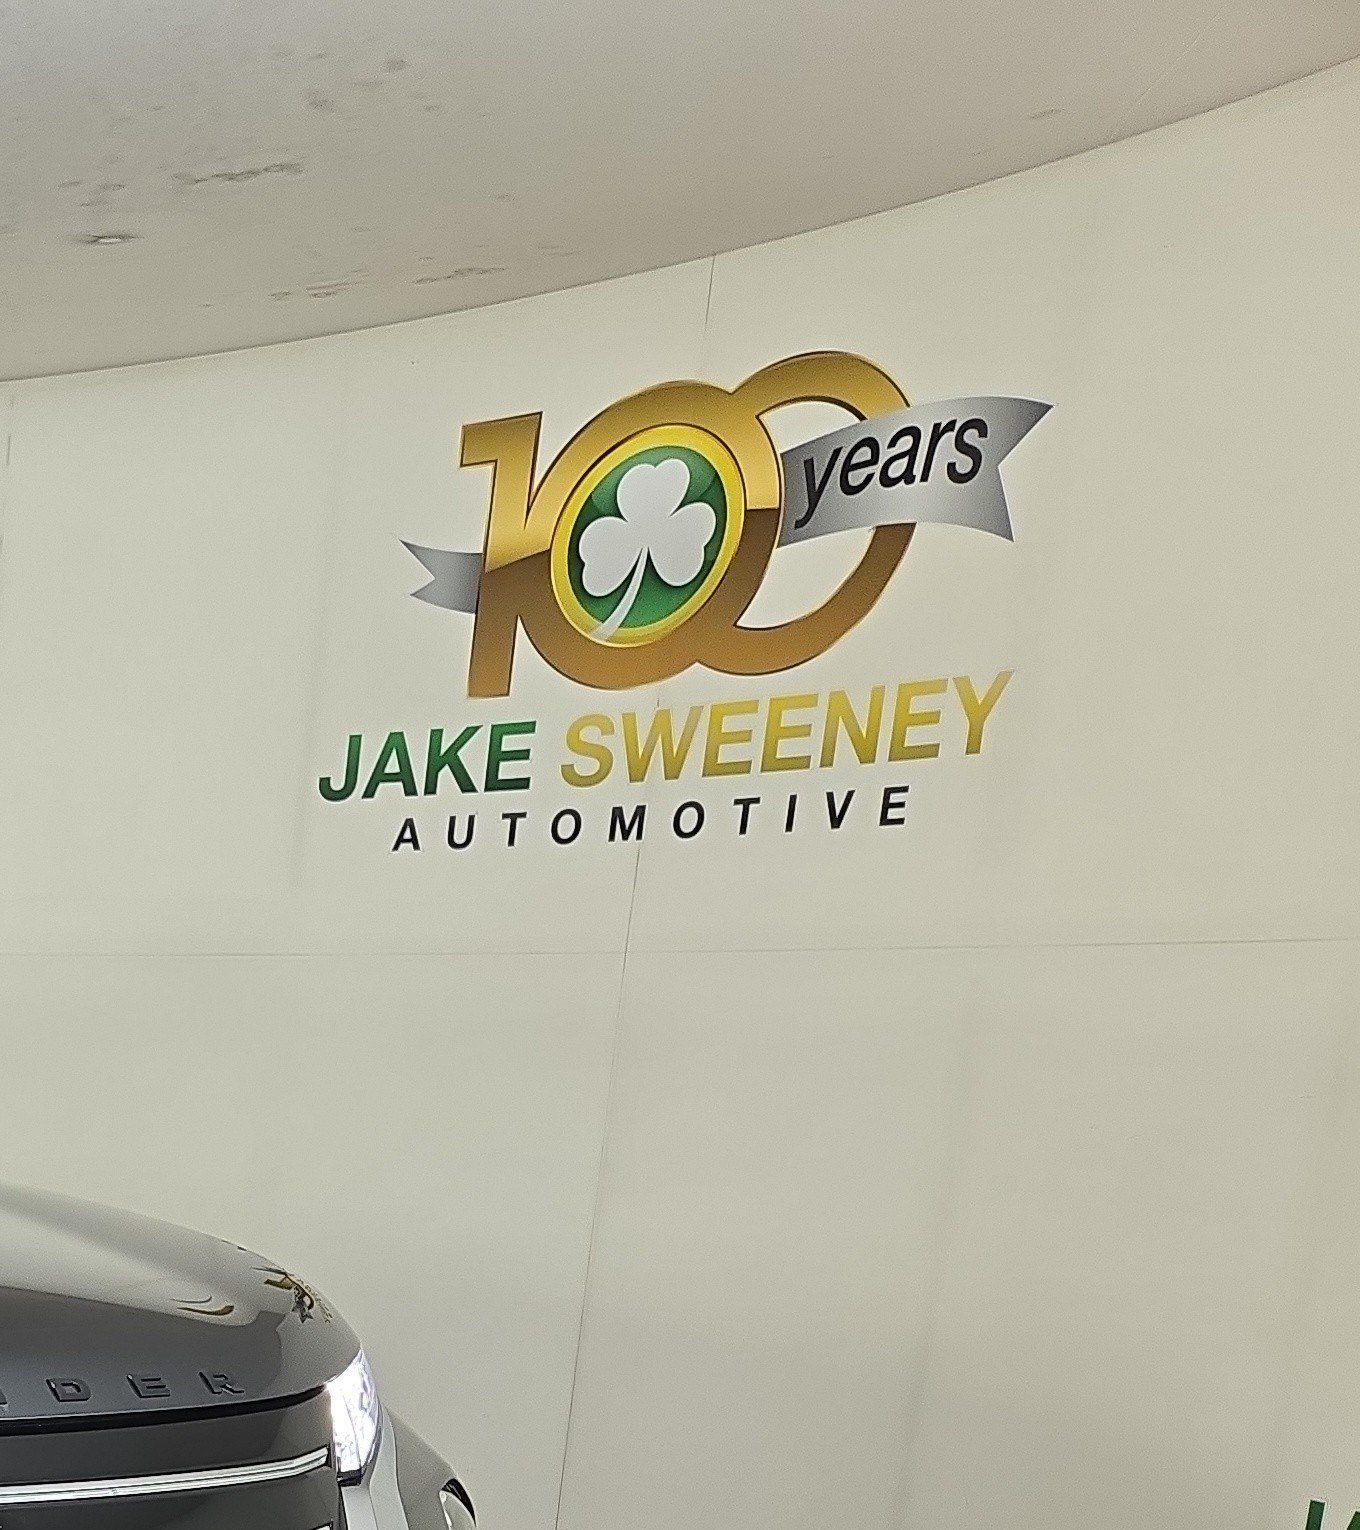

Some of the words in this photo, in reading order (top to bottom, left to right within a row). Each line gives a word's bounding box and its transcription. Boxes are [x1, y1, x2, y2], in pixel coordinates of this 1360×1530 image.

[794, 414, 989, 530] years
[319, 720, 538, 802] JAKE
[560, 670, 1015, 788] SWEENEY
[392, 785, 910, 852] AUTOMOTIVE
